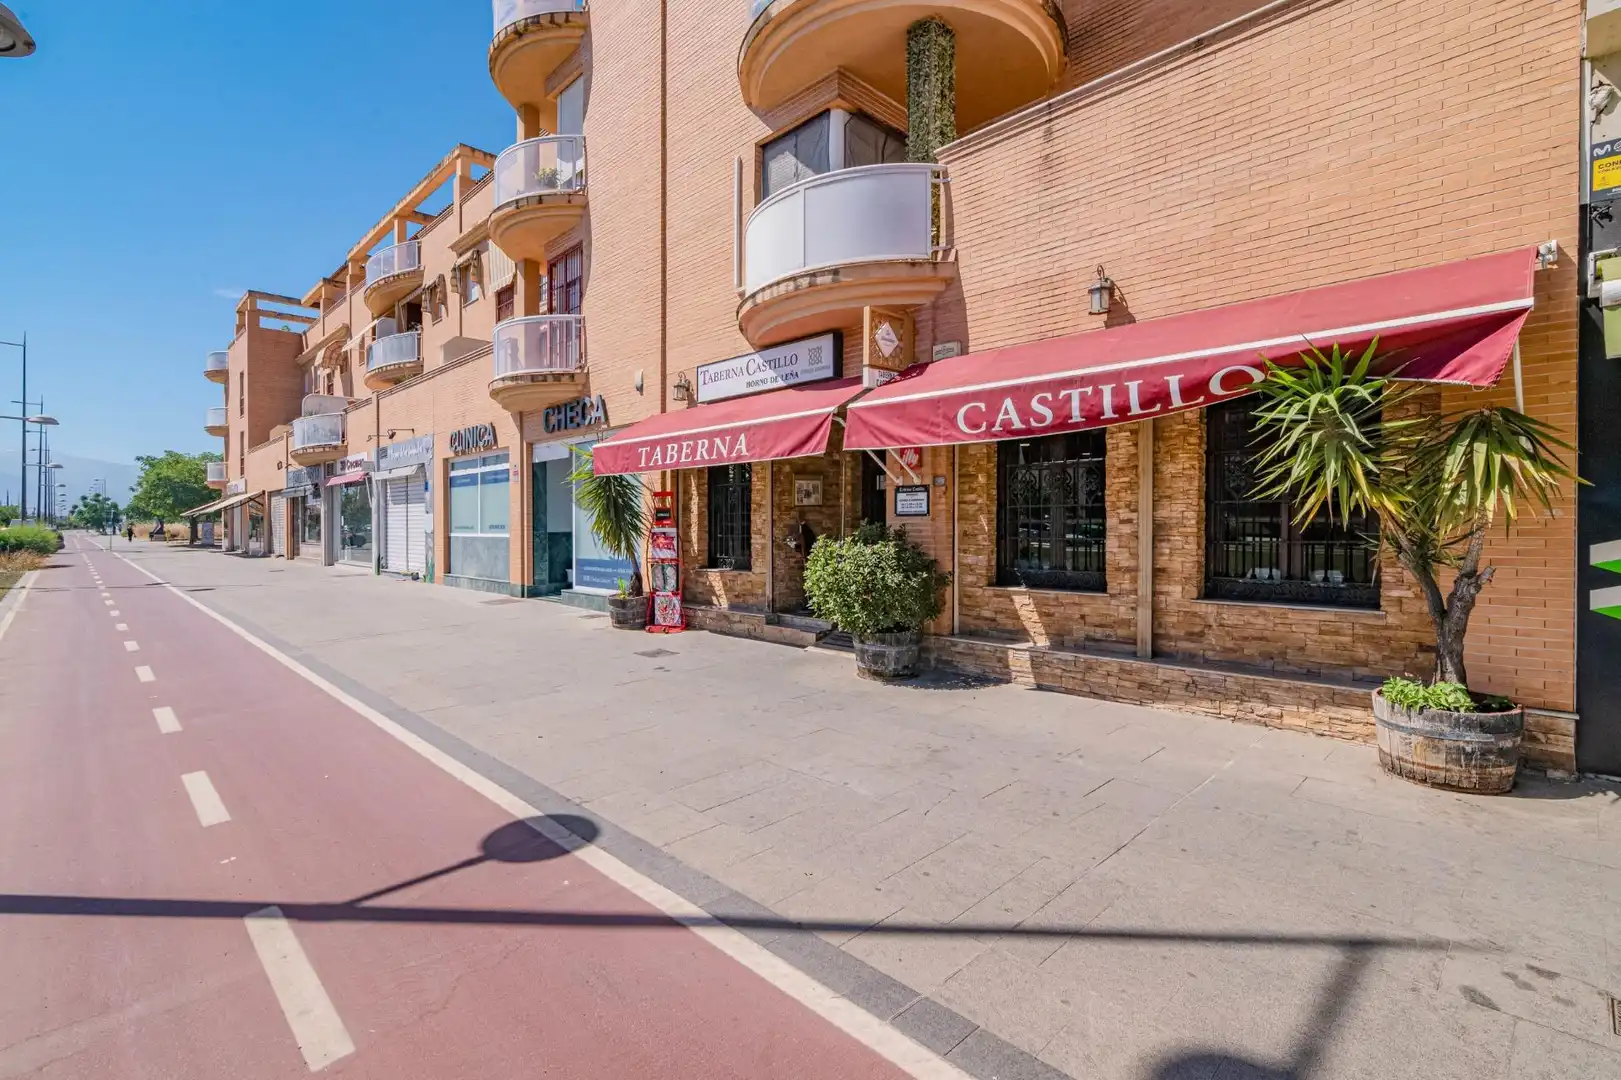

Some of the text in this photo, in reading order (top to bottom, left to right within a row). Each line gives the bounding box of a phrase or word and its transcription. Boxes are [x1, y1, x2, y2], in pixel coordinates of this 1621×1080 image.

[700, 367, 744, 386] TABERNA
[745, 353, 798, 376] CASTILLO
[746, 371, 799, 388] HORNO DE LEÑA
[543, 394, 607, 433] CHECA
[956, 365, 1266, 434] CASTILLO
[638, 432, 749, 467] TABERNA
